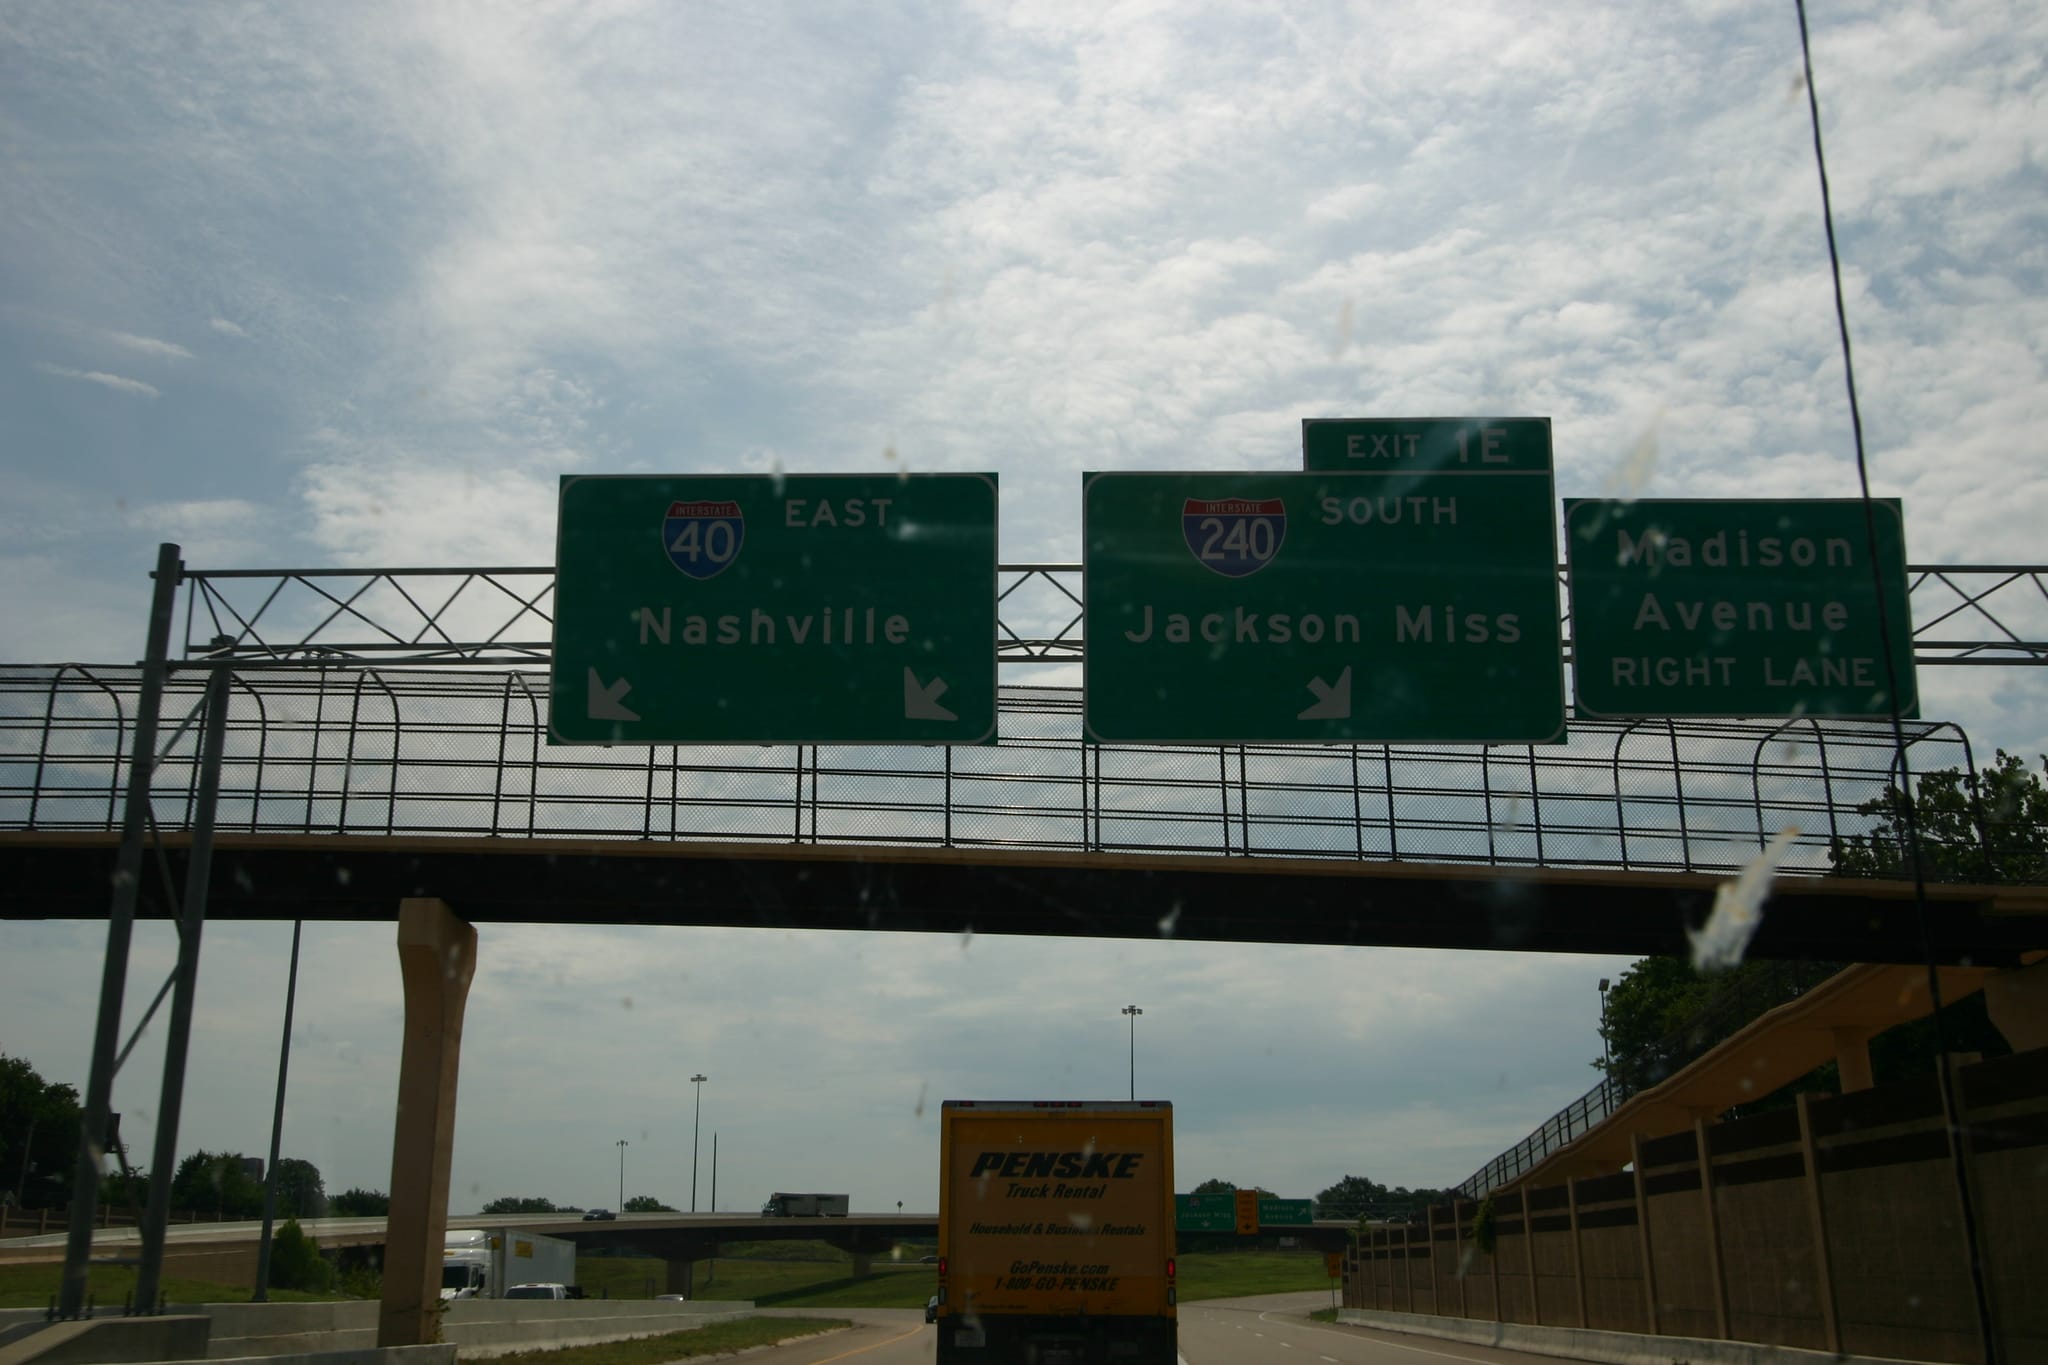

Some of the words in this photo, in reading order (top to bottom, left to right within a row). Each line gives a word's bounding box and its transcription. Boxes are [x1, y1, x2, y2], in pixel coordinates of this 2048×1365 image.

[1346, 434, 1421, 459] EXIT
[1455, 428, 1510, 464] 1E
[675, 505, 734, 517] INTERSTATE
[785, 499, 893, 528] EAST
[1205, 502, 1263, 514] INTERSTATE
[1320, 497, 1457, 525] SOUTH
[670, 520, 735, 563] 40
[1199, 518, 1275, 561] 240
[1617, 529, 1853, 568] Madison
[1124, 605, 1361, 644] Jackson
[1396, 604, 1522, 644] Miss
[1633, 592, 1849, 631] Avenue
[639, 607, 911, 646] Nashville
[1611, 656, 1737, 687] RIGHT
[1763, 656, 1877, 687] LANE
[970, 1152, 1144, 1179] PENSKE
[1005, 1183, 1049, 1199] Truck
[1053, 1183, 1107, 1199] Rental
[969, 1223, 1033, 1235] Household
[1033, 1223, 1043, 1235] &
[1101, 1223, 1145, 1235] Rentals
[1010, 1260, 1110, 1275] GoPenske.com
[994, 1277, 1120, 1291] 1-800-GO-PENSKE
